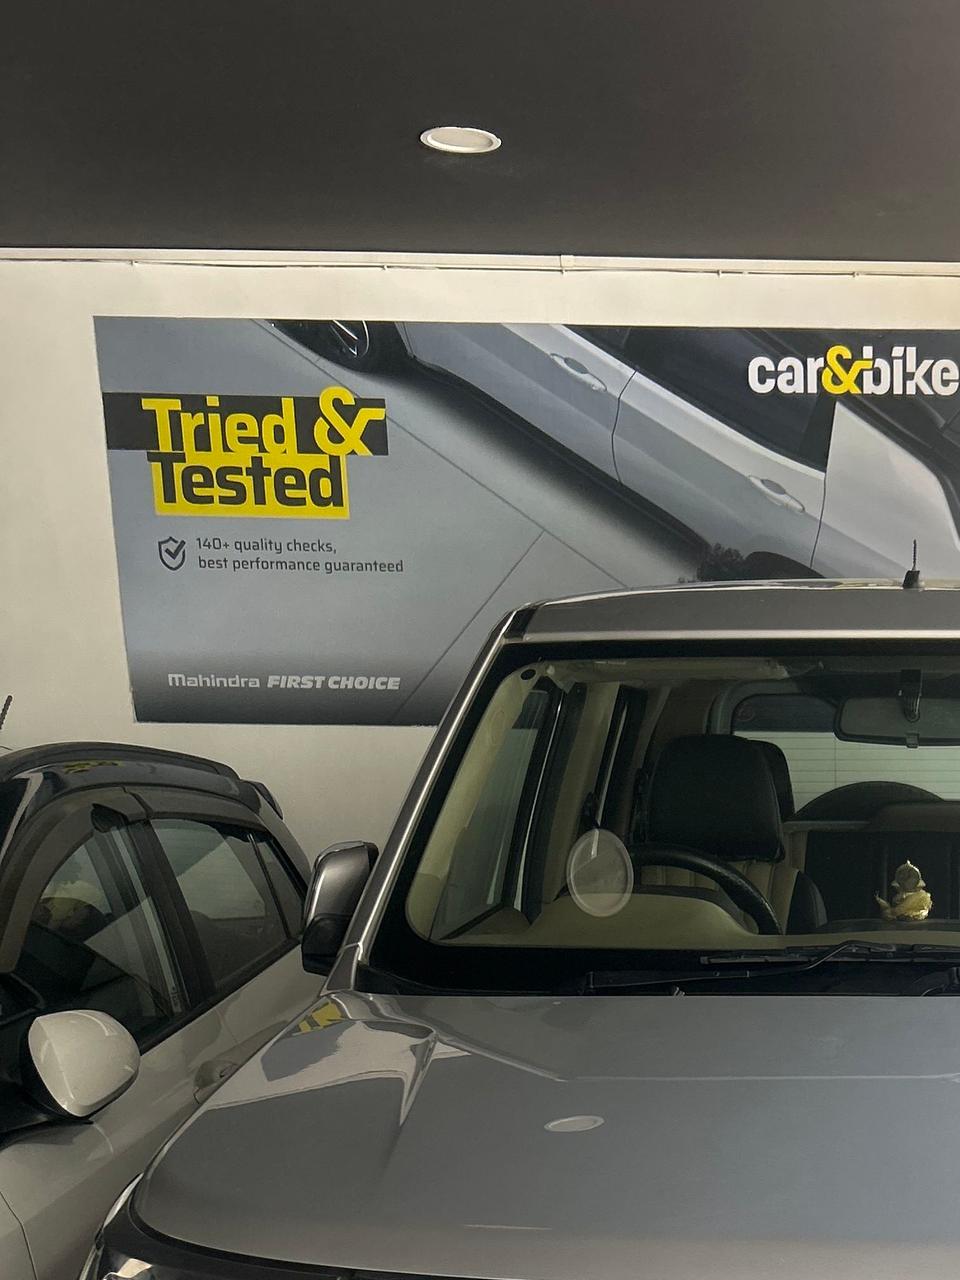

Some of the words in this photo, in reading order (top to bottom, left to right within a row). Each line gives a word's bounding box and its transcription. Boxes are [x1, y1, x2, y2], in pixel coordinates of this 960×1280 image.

[748, 345, 960, 396] car&bike
[141, 395, 297, 455] Tried
[313, 386, 386, 456] &
[147, 450, 344, 508] Tested
[196, 537, 230, 550] 140+
[234, 537, 283, 554] quality
[286, 539, 337, 554] checks,
[199, 555, 229, 569] best
[232, 556, 321, 572] performance
[324, 560, 404, 574] guaranteed
[168, 673, 261, 688] Mahindra
[267, 675, 326, 689] FIRST
[328, 676, 401, 690] CHOICE
